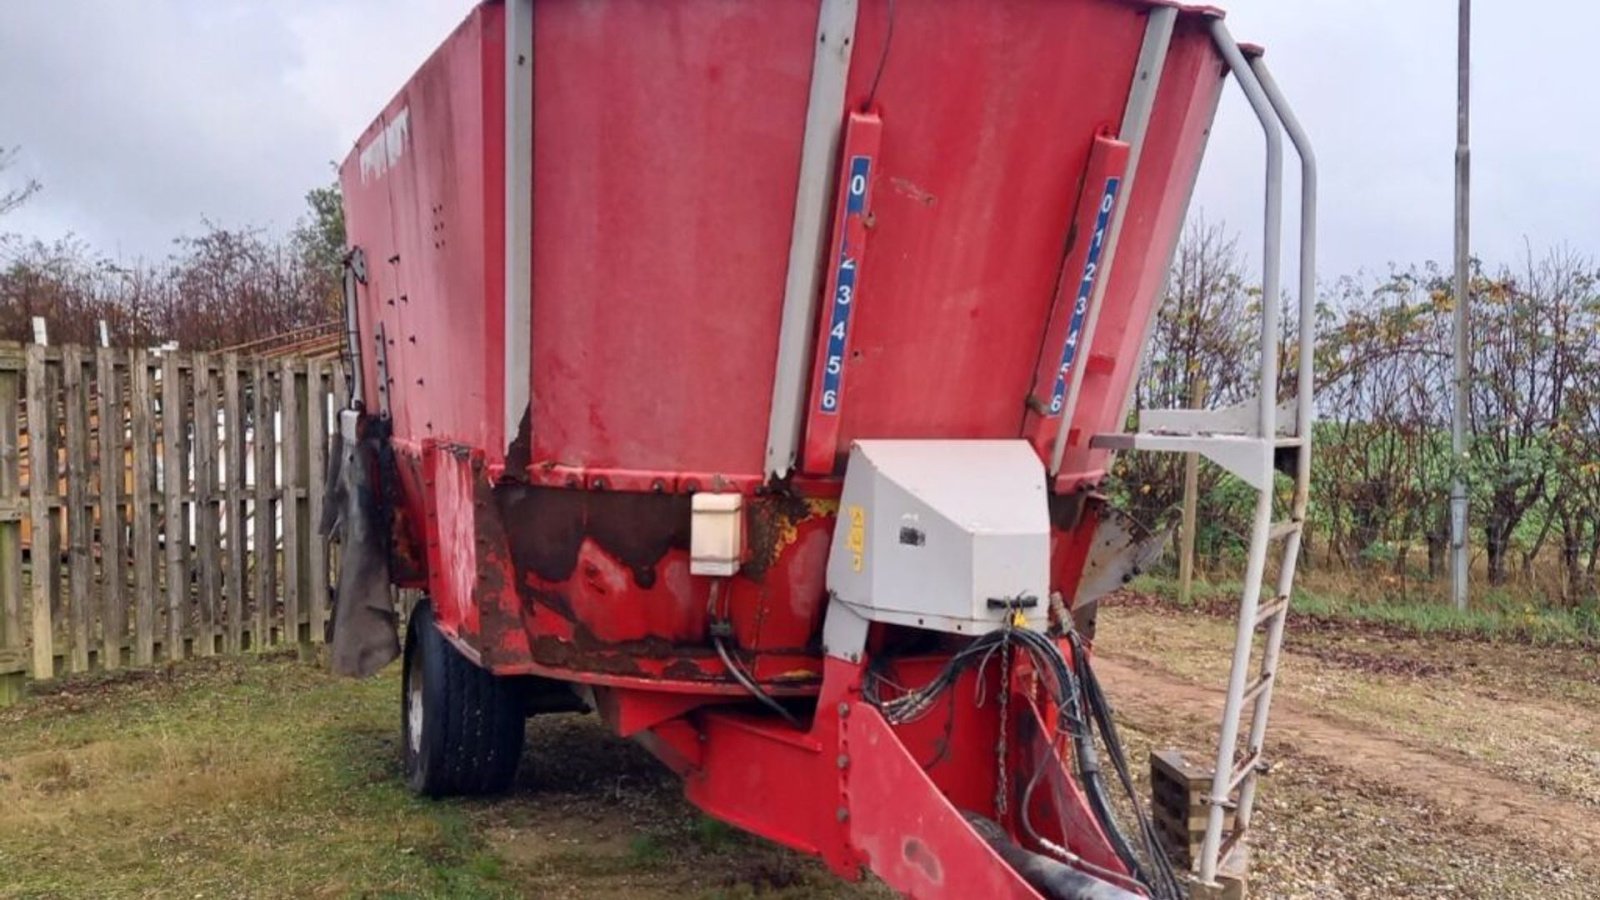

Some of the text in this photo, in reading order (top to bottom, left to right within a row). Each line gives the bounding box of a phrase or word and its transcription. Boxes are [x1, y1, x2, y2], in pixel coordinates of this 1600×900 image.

[851, 174, 866, 196] 0
[1101, 193, 1114, 213] 0
[1095, 228, 1104, 247] 1
[1083, 262, 1097, 281] 2
[837, 284, 852, 305] 3
[1076, 296, 1087, 316] 3
[831, 320, 846, 341] 4
[1066, 329, 1078, 347] 4
[827, 354, 841, 375] 5
[823, 389, 837, 409] 6
[1050, 394, 1062, 413] 6
